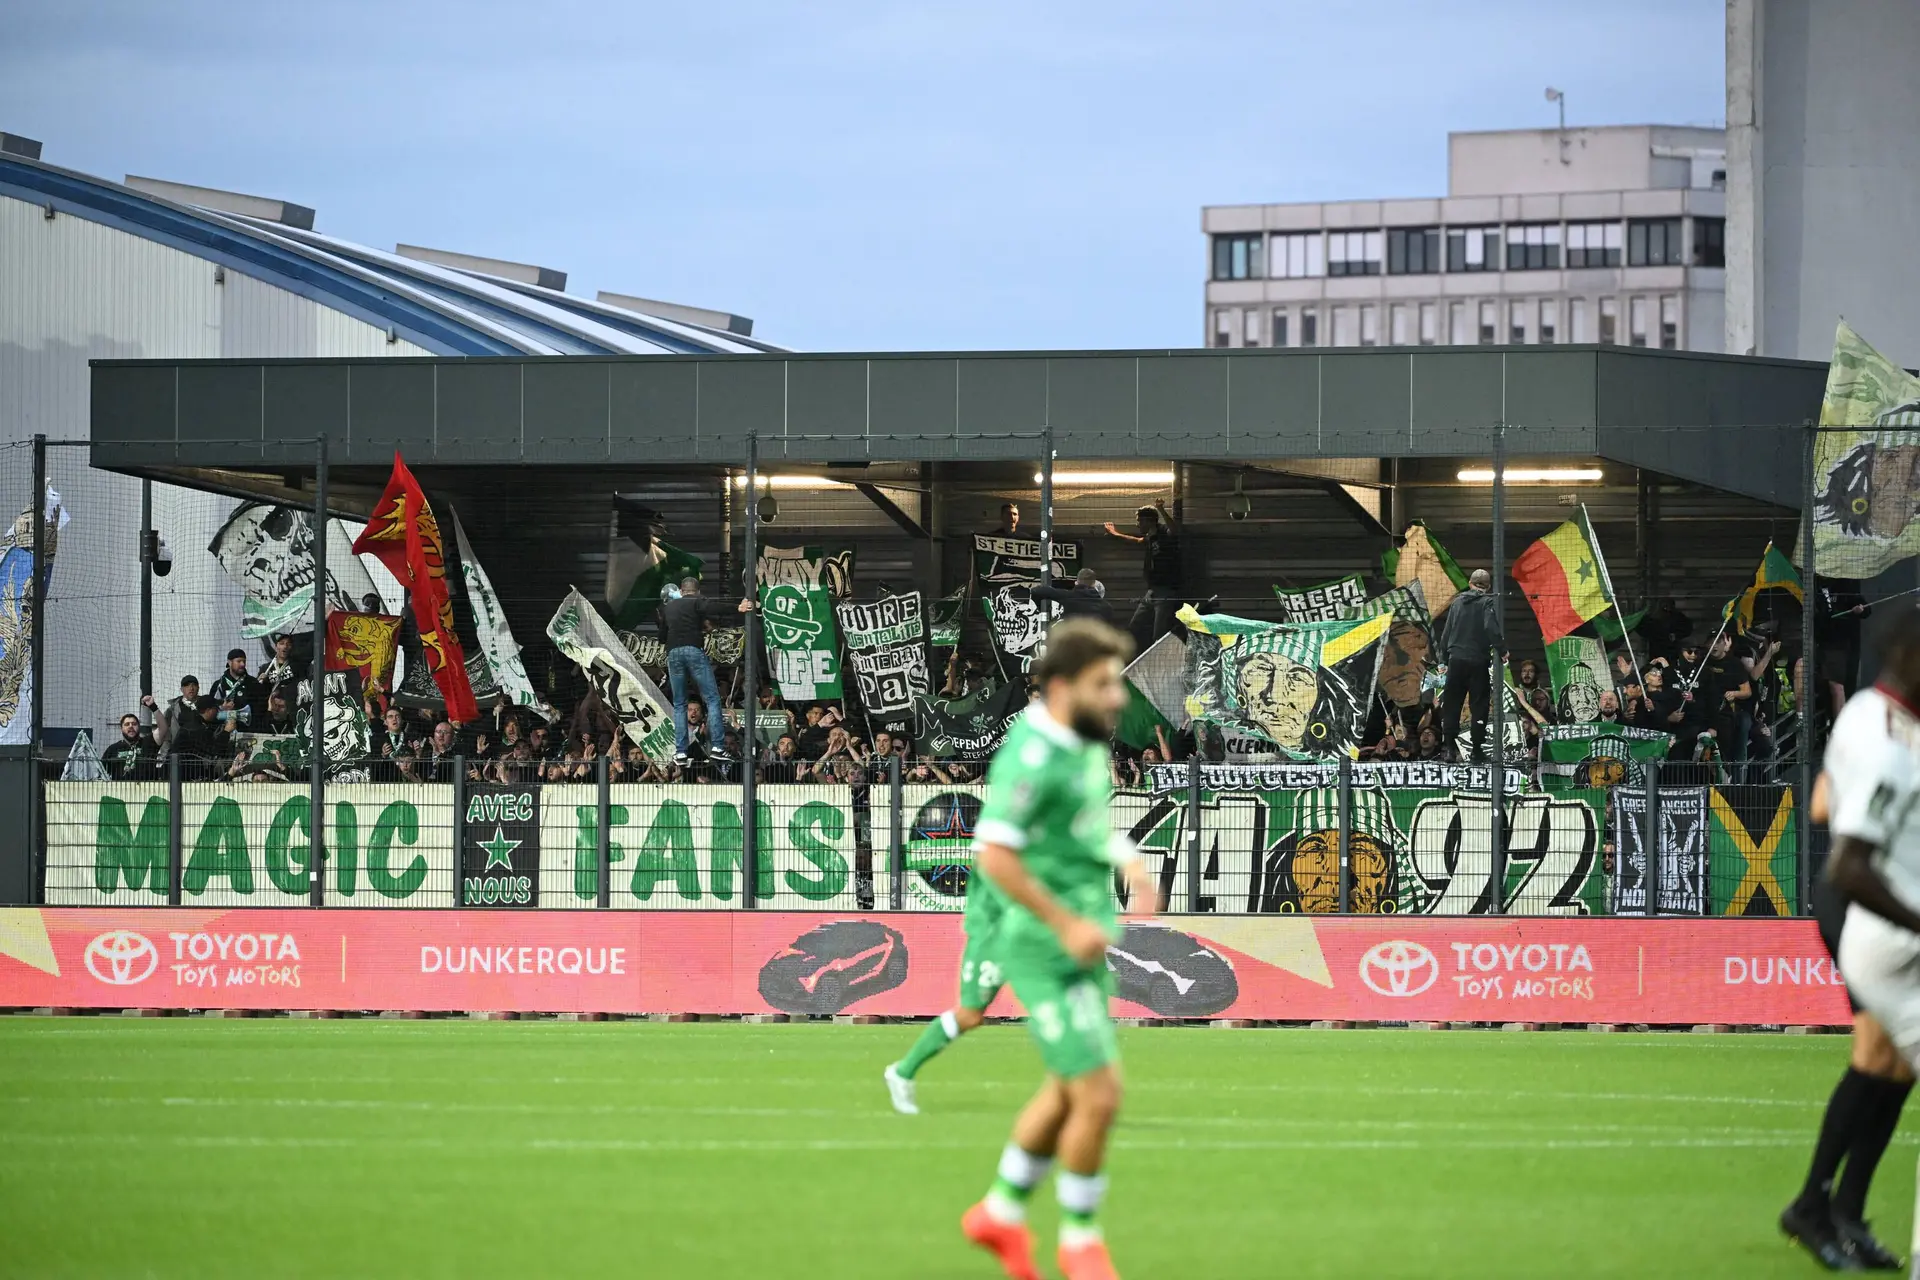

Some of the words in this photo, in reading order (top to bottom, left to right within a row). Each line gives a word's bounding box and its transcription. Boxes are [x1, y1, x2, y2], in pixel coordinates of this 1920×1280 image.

[978, 539, 1074, 558] ST-ETIENE
[775, 596, 798, 615] OF
[1226, 738, 1281, 755] CLERM
[466, 792, 533, 823] AVEC
[95, 795, 428, 899] MAGIC
[574, 799, 849, 901] FANS
[1410, 795, 1596, 915] 92
[464, 876, 531, 904] NOUS
[168, 932, 300, 961] TOYOTA
[421, 946, 626, 974] DUNKERQUE
[1451, 943, 1593, 972] TOYOTA
[1724, 956, 1843, 985] DUNKE
